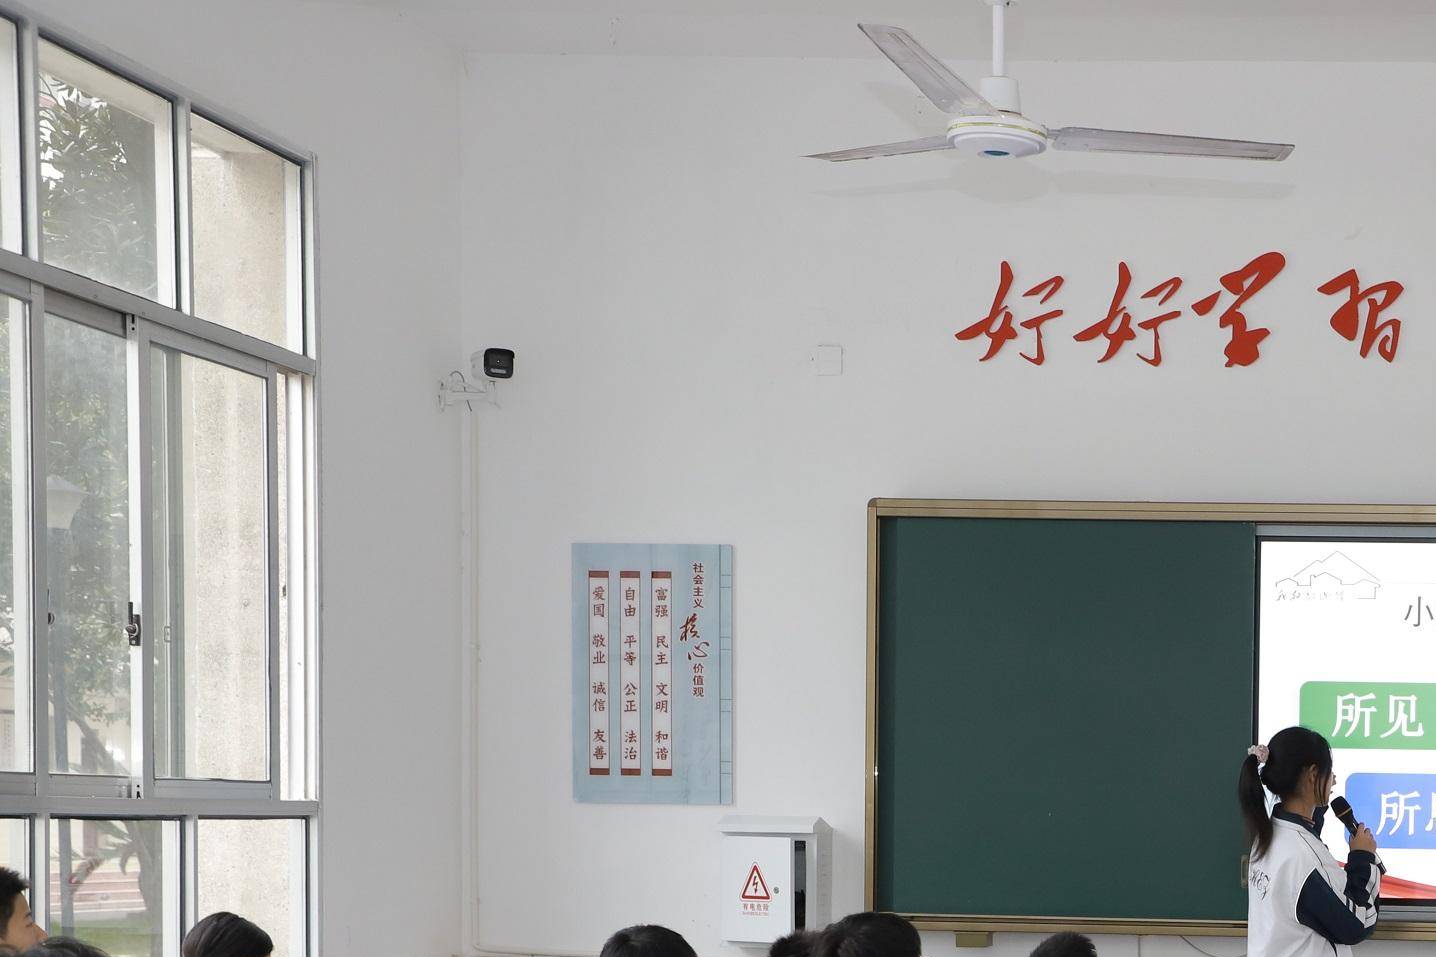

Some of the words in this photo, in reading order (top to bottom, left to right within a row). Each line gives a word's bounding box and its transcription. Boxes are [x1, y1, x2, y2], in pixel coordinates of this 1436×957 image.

[955, 251, 1405, 368] 好好学习
[592, 586, 607, 617] 爱国
[624, 587, 637, 617] 自由
[655, 587, 669, 618] 富强
[592, 633, 607, 664] 敬业
[624, 635, 637, 665] 平等
[655, 635, 669, 665] 民主
[592, 682, 607, 712] 诚信
[624, 682, 637, 713] 公正
[655, 682, 669, 713] 文明
[1331, 692, 1425, 739] 所见
[592, 729, 607, 760] 友善
[624, 730, 637, 760] 法治
[655, 730, 669, 761] 和谐
